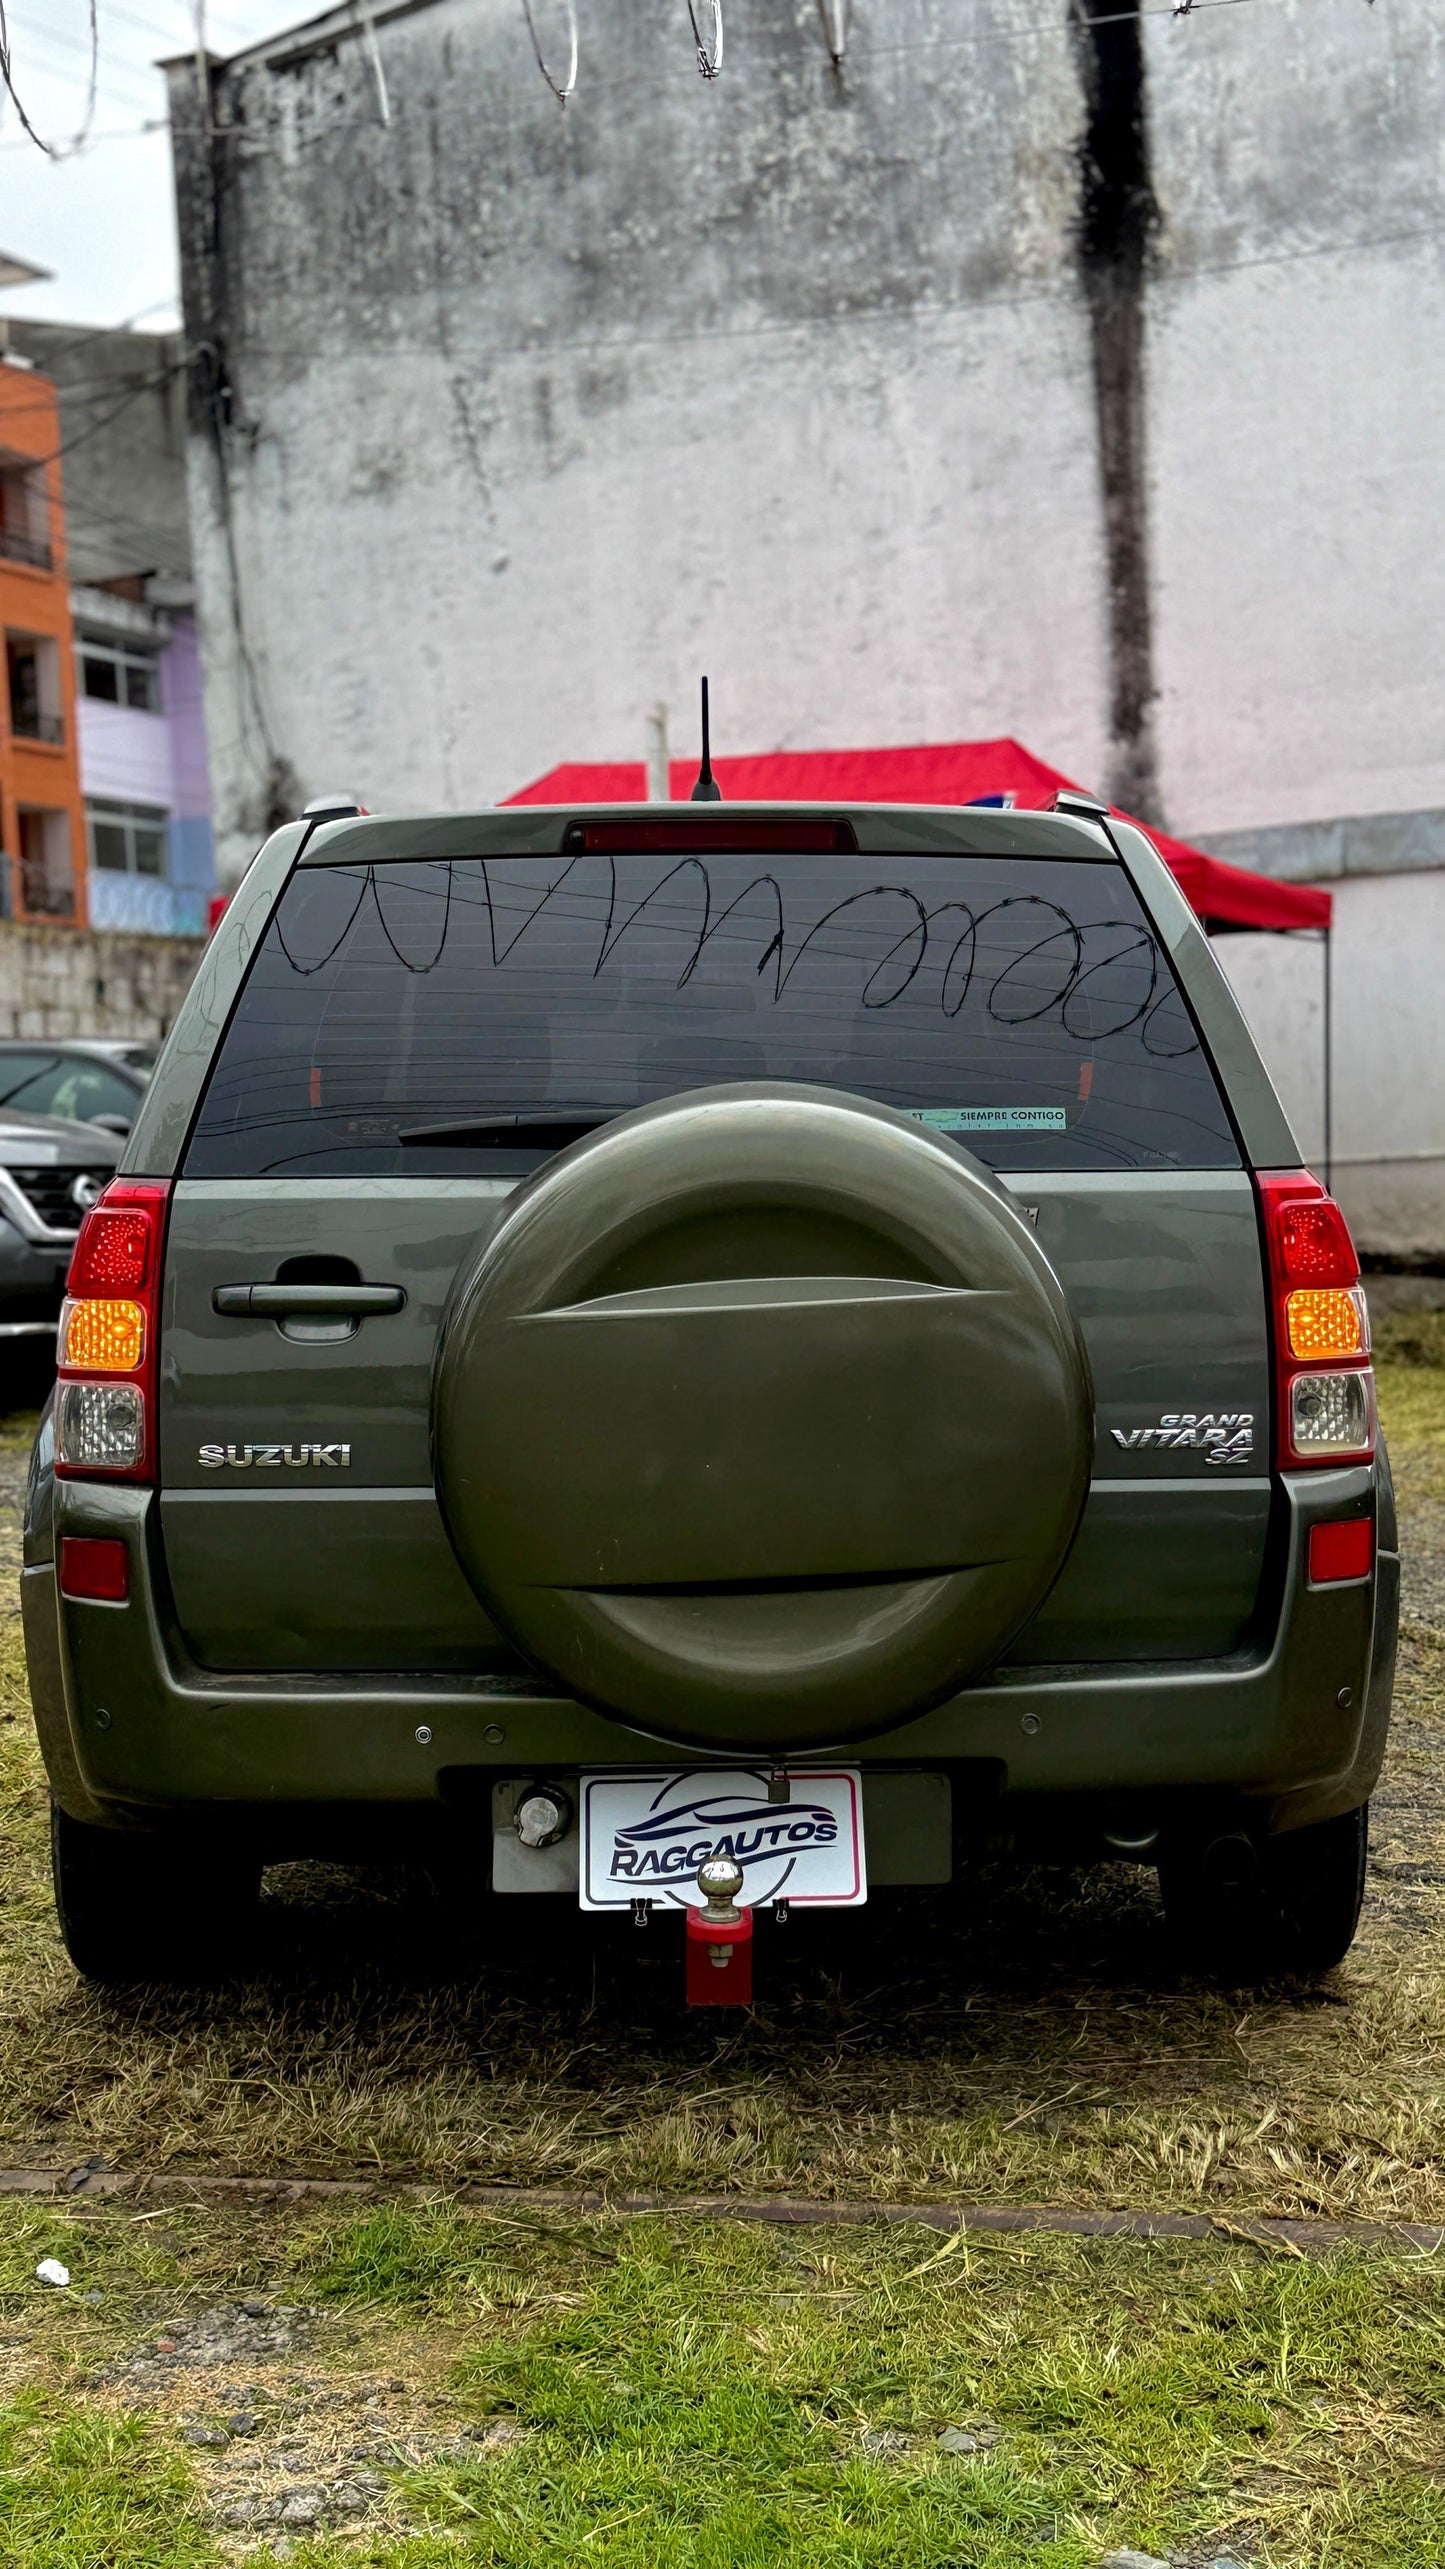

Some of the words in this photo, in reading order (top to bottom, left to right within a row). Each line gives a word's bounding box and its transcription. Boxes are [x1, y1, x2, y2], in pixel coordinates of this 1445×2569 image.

[960, 1111, 1007, 1121] SIEMPRE
[1011, 1111, 1064, 1120] CONTIGO
[1159, 1414, 1254, 1427] GRAND
[1110, 1428, 1253, 1448] VITARA
[198, 1444, 351, 1467] SUZUKI
[1205, 1448, 1254, 1464] SZ
[610, 1822, 838, 1876] RAGGAUTOS
